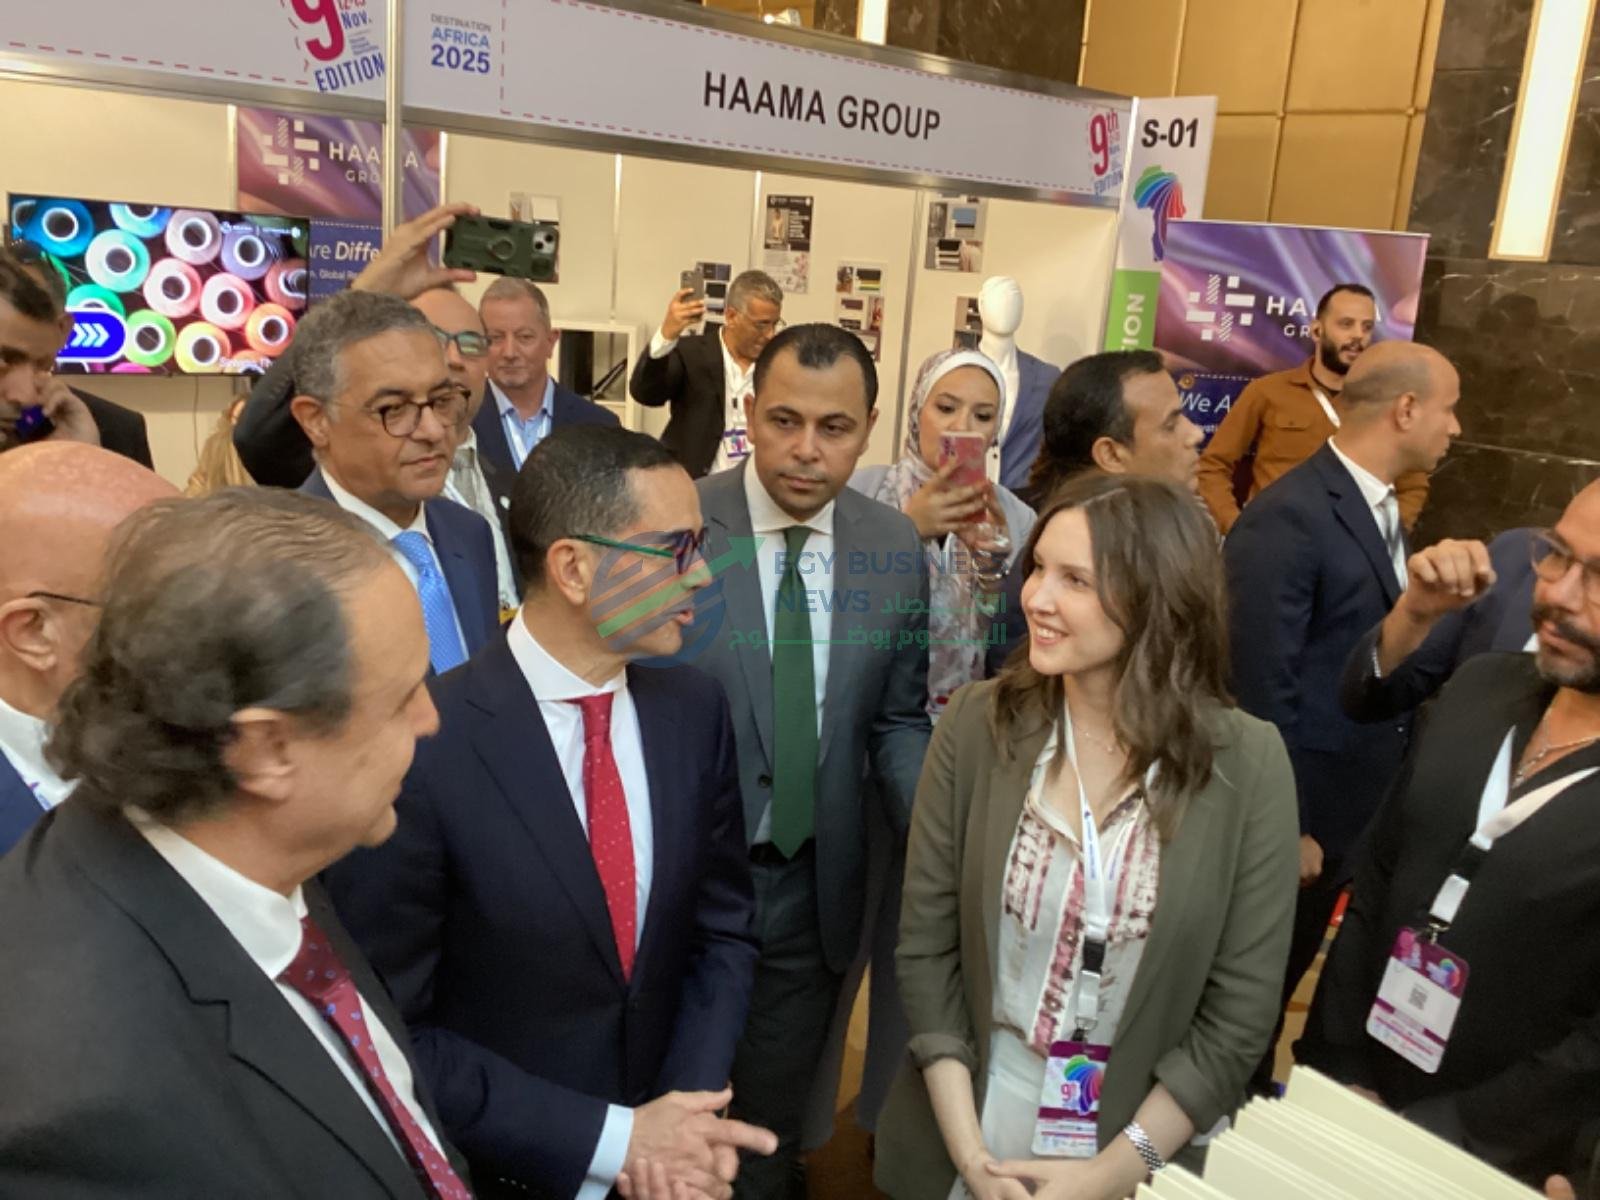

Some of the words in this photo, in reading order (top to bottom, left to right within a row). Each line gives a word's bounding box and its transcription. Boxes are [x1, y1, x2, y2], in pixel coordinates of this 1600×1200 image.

[431, 13, 491, 32] DESTINATION
[432, 26, 490, 49] AFRICA
[314, 52, 385, 91] EDITION
[431, 44, 490, 73] 2025
[704, 70, 826, 125] HAAMA
[837, 94, 941, 140] GROUP
[1141, 117, 1199, 148] S-01
[328, 141, 419, 168] HAAA
[1121, 294, 1146, 350] ION
